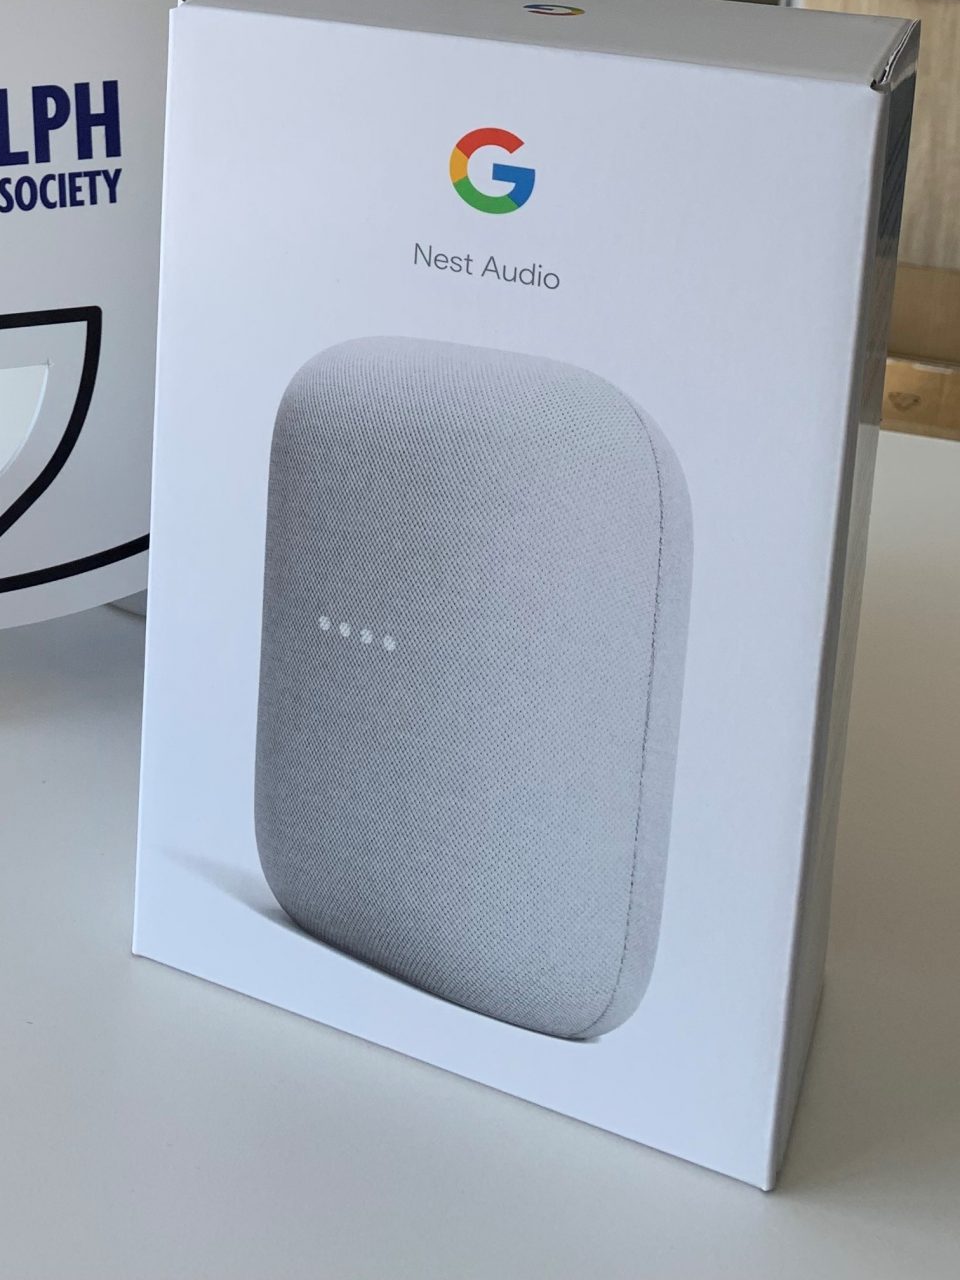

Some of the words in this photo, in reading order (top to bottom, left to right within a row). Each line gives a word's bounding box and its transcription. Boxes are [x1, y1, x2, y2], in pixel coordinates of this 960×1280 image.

[449, 127, 536, 215] G
[413, 242, 473, 276] Nest
[481, 255, 561, 290] Audio
